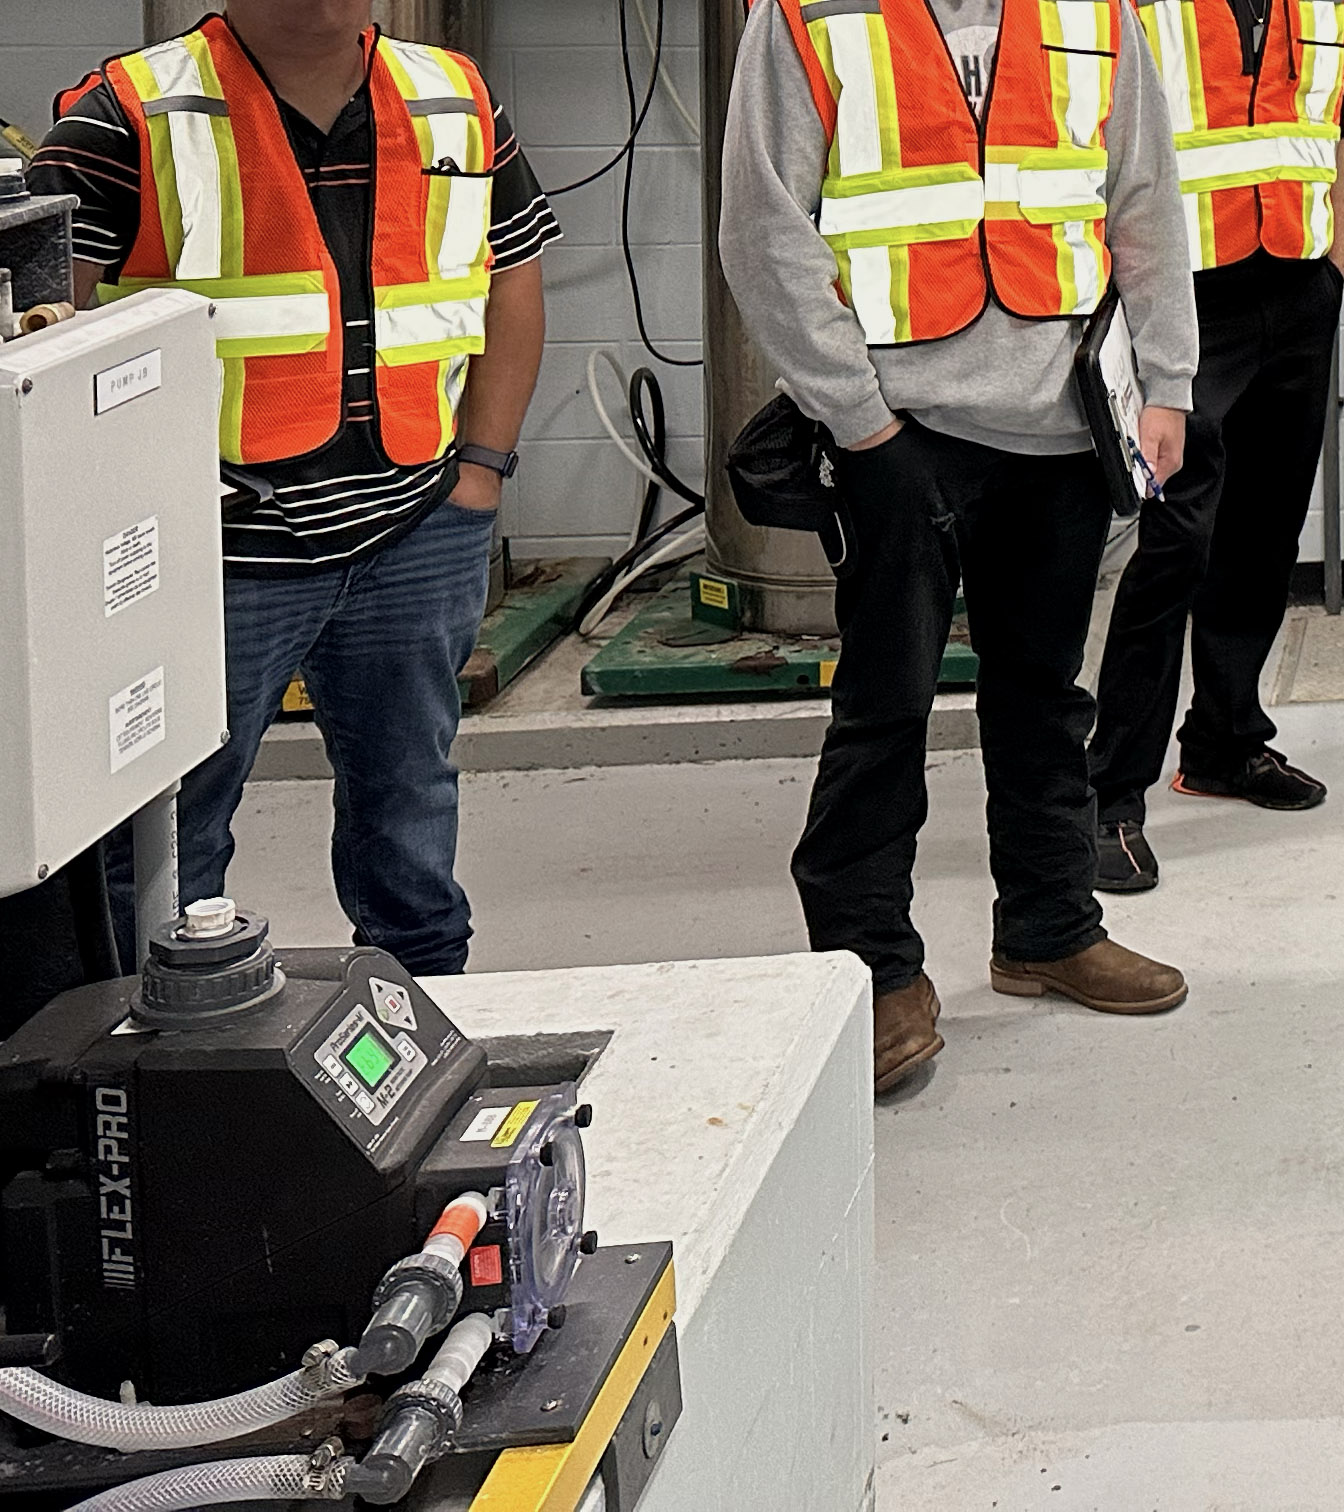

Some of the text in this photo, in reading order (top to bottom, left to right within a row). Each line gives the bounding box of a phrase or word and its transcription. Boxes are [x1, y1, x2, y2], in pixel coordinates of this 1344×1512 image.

[109, 372, 135, 393] PUMP
[376, 1083, 397, 1110] M-2
[95, 1087, 134, 1263] FLEX-PRO
